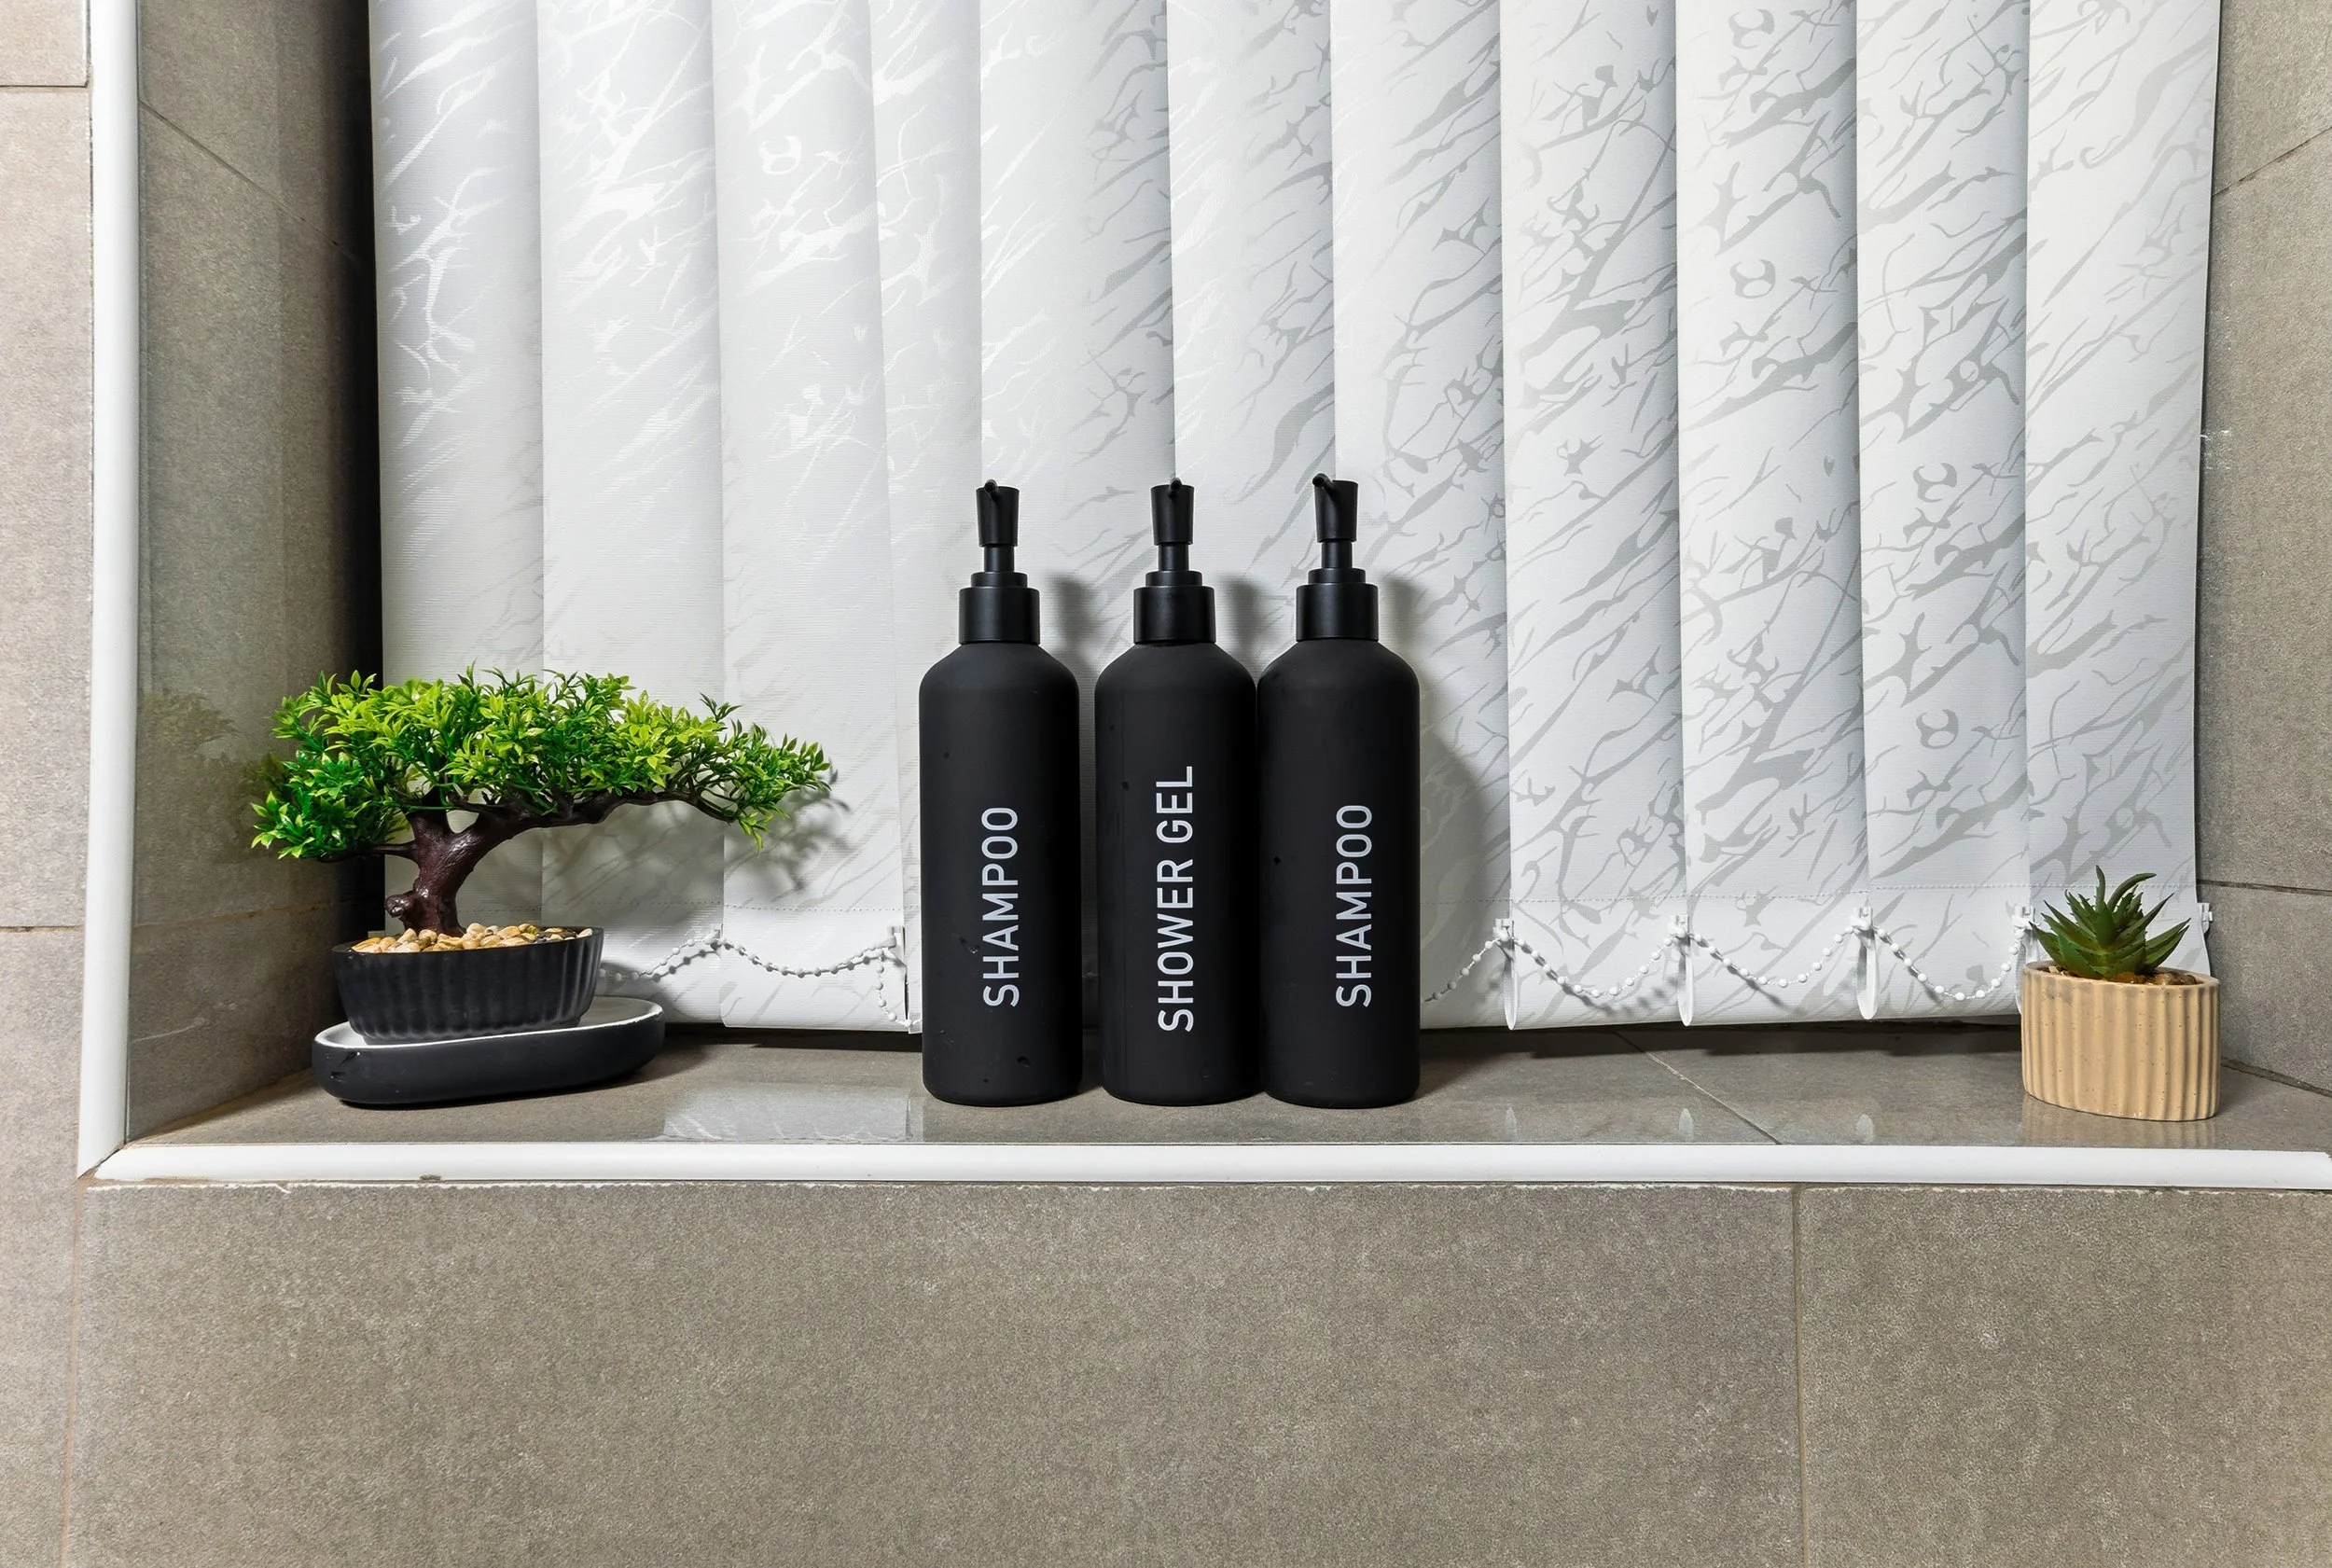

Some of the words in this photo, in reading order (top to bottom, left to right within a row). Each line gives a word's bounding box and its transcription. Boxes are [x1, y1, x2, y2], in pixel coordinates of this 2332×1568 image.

[1154, 765, 1195, 844] GEL
[979, 805, 1020, 1008] SHAMPOO
[1155, 857, 1195, 1034] SHOWER
[1334, 804, 1374, 1008] SHAMPOO
